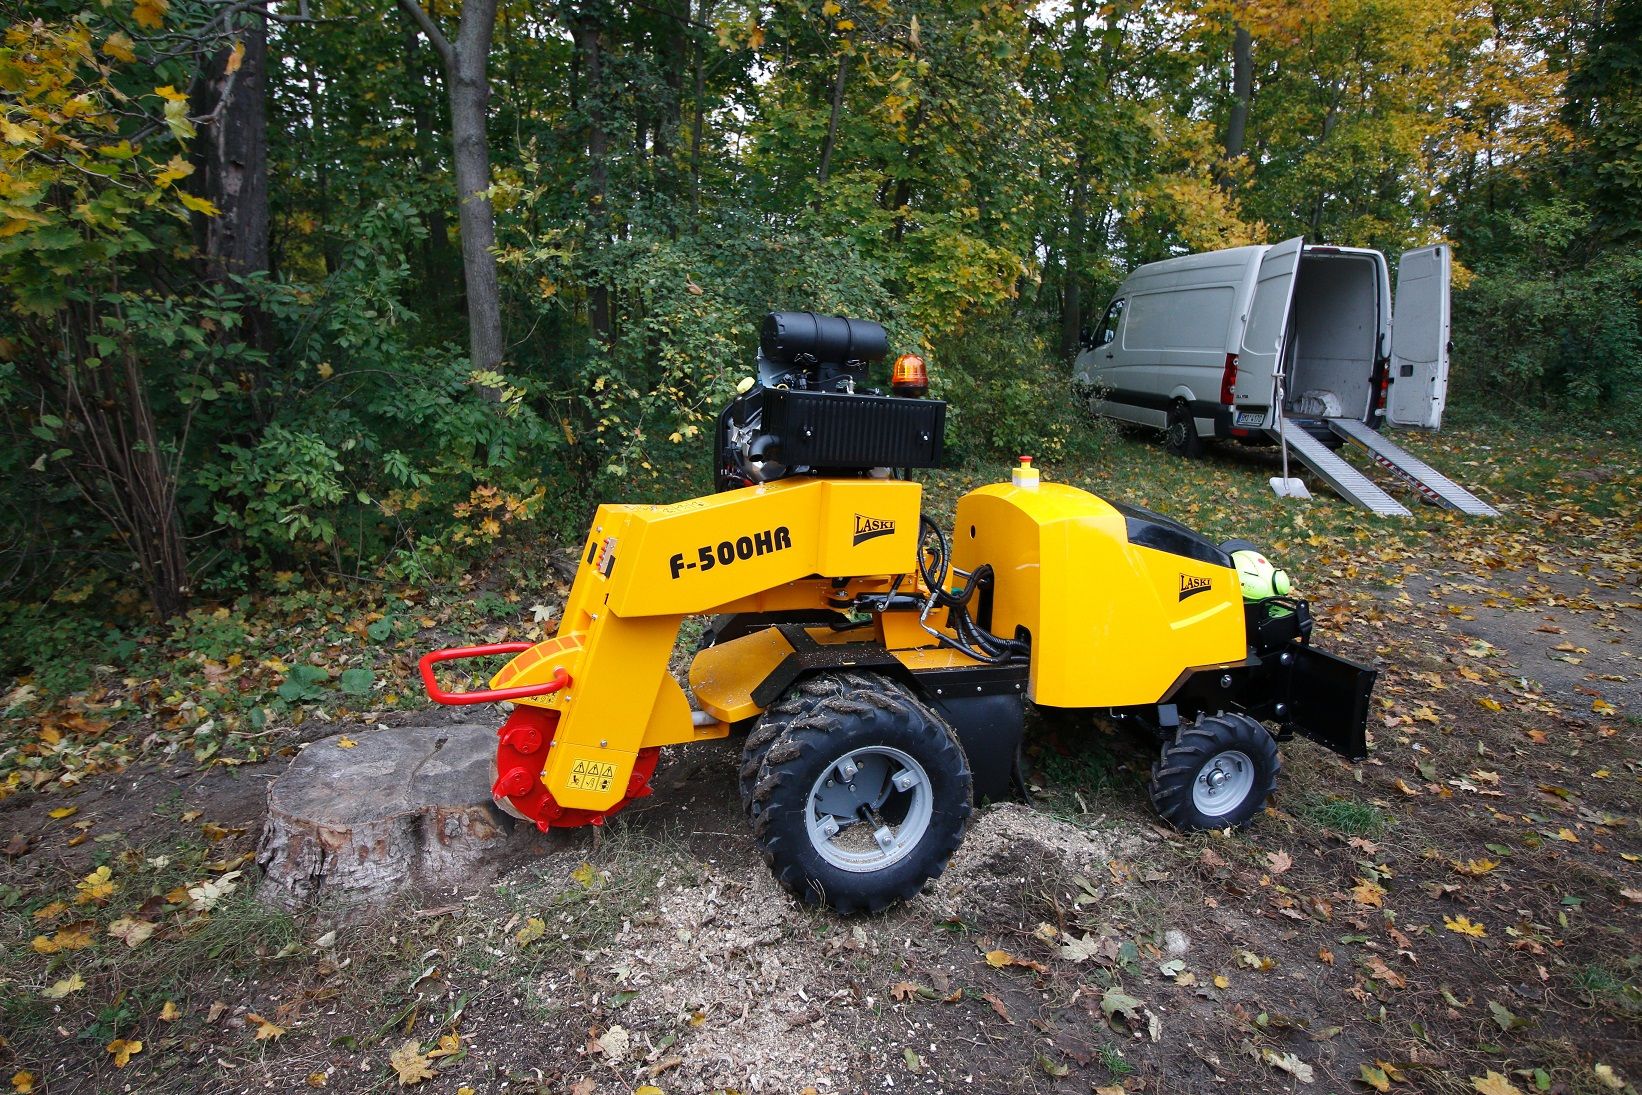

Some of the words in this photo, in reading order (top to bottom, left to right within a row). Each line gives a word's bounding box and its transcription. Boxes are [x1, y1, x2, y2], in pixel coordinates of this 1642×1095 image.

[855, 515, 894, 534] LASKI
[669, 526, 792, 580] F-500HR
[1180, 574, 1211, 592] LASKI
